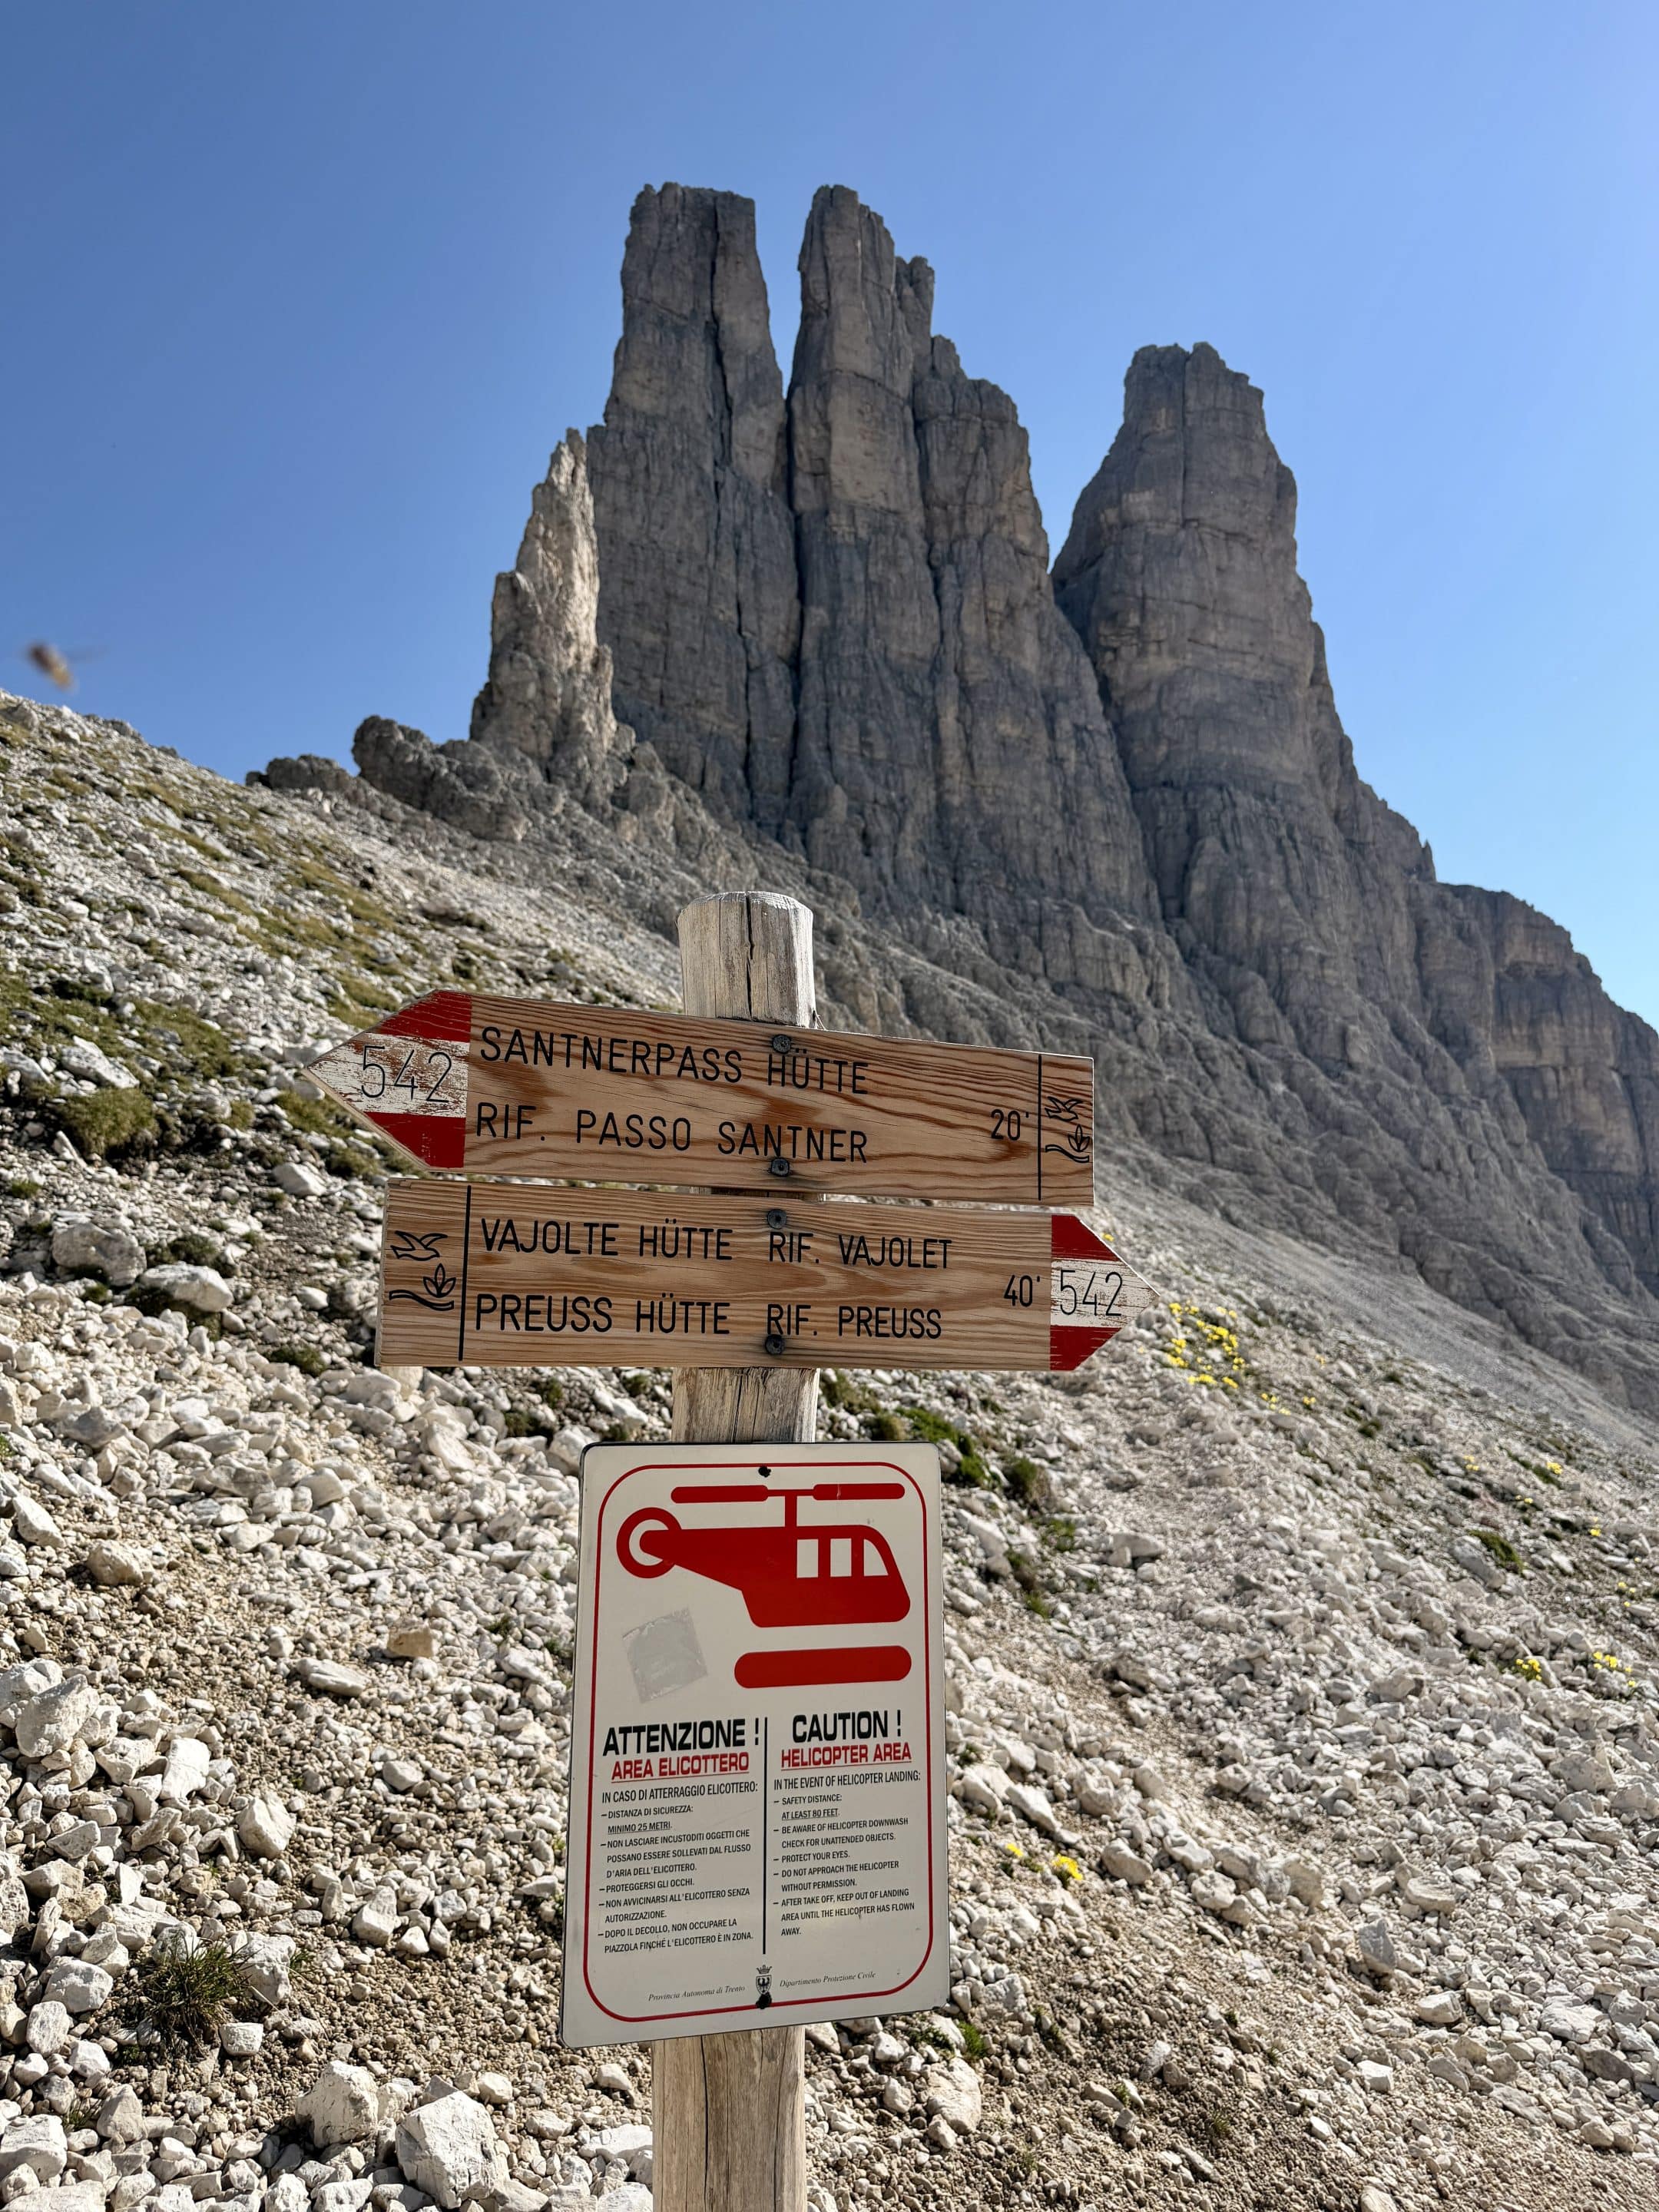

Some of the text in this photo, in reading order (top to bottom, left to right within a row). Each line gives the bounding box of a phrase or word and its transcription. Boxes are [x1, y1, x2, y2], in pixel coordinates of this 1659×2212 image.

[480, 1026, 868, 1094] SANTNERPASS HÜTTE
[360, 1045, 452, 1103] 542
[477, 1102, 867, 1164] RIF. PASSO SANTNER
[991, 1109, 1030, 1141] 20'
[481, 1217, 952, 1269] VAJOLTE HÜTTE RIF. VAJOLET
[1003, 1274, 1041, 1307] 40'
[1058, 1268, 1123, 1316] 542
[475, 1292, 941, 1339] PREUSS HÜTTE RIF. PREUSS
[793, 1710, 888, 1743] CAUTION
[602, 1719, 745, 1756] ATTENZIONE
[781, 1742, 912, 1767] HELICOPTER AREA
[611, 1752, 749, 1780] AREA ELICOTTERO
[774, 1770, 921, 1790] IN THE EVENT OF HELICOPTER LANDING:
[602, 1781, 758, 1803] IN CASO DI ATTERRAGGIO ELICOTTERO:
[782, 1794, 842, 1805] SAFETY DISTANCE:
[608, 1808, 642, 1819] DISTANZA
[653, 1805, 694, 1815] SICUREZZA:
[791, 1810, 811, 1818] LEAST
[813, 1809, 821, 1817] 80
[608, 1824, 636, 1833] MINIMO
[793, 1823, 816, 1833] AWARE
[827, 1820, 867, 1831] HELICOPTER
[869, 1817, 909, 1827] DOWNWASH
[608, 1839, 623, 1849] NON
[625, 1837, 659, 1846] LASCIARE
[661, 1833, 704, 1843] INCUSTODITI
[707, 1831, 733, 1840] OGGETTI
[782, 1839, 805, 1848] CHECK
[806, 1838, 820, 1846] FOR
[821, 1835, 864, 1846] UNATTENDED
[607, 1844, 751, 1863] POSSANO ESSERE SOLLEVATI DAL FLUSSO
[782, 1853, 811, 1863] PROTECT
[813, 1852, 830, 1860] YOUR
[808, 1866, 844, 1875] APPROACH
[859, 1861, 899, 1870] HELICOPTER
[606, 1881, 655, 1892] PROTEGGERSI
[781, 1883, 812, 1892] WITHOUT
[606, 1899, 621, 1908] NON
[623, 1895, 667, 1906] AVVICINARSI
[727, 1888, 750, 1896] SENZA
[781, 1898, 802, 1907] AFTER
[803, 1896, 820, 1905] TAKE
[821, 1895, 836, 1903] OFF,
[837, 1893, 854, 1902] KEEP
[855, 1892, 868, 1900] OUT
[880, 1889, 909, 1898] LANDING
[781, 1912, 800, 1922] AREA
[800, 1910, 820, 1919] UNTIL
[835, 1905, 876, 1916] HELICOPTER
[876, 1904, 890, 1912] HAS
[892, 1902, 915, 1912] FLOWN
[605, 1918, 737, 1938] DOPO IL DECOLLO, NON OCCUPARE LA
[604, 1943, 637, 1954] PIAZZOLA
[724, 1932, 730, 1941] IN
[780, 1977, 822, 1987] Dipartimento
[823, 1973, 856, 1982] Protezione
[648, 1992, 680, 2002] Provincia
[682, 1988, 714, 1997] Autonoma
